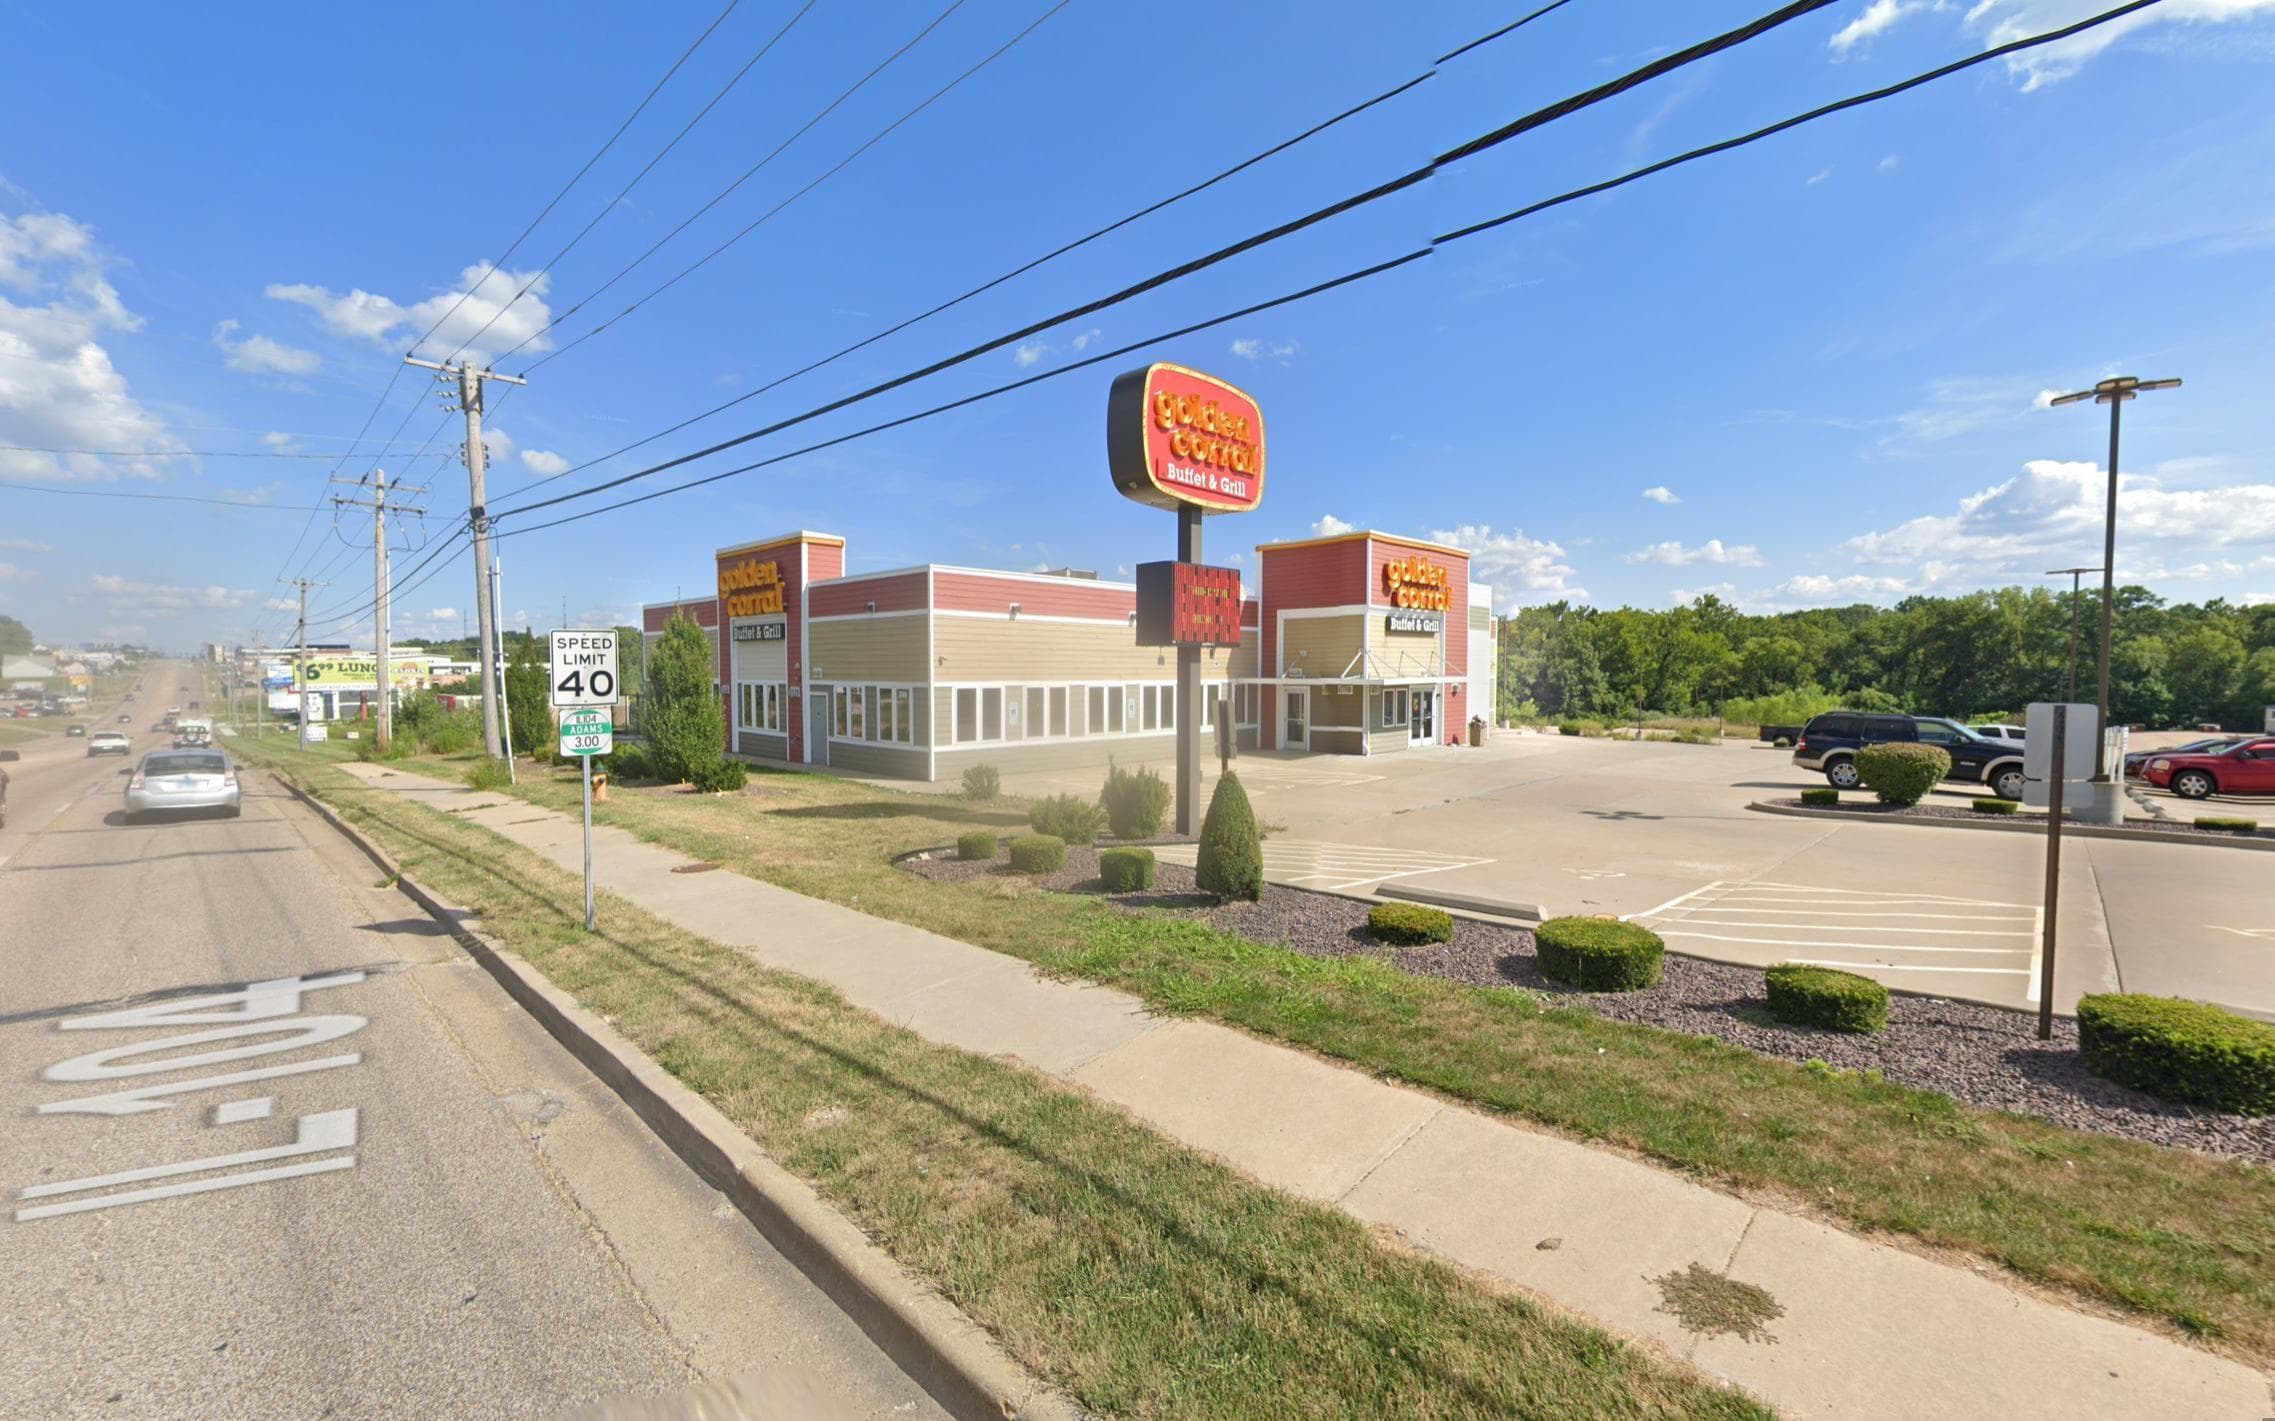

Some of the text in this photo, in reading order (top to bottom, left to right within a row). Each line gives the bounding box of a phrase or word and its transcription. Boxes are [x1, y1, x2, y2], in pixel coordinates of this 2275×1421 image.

[1153, 390, 1250, 441] golden
[1170, 429, 1258, 473] corral
[1167, 462, 1246, 497] Buffet & Grill
[720, 559, 777, 599] golden
[1387, 556, 1448, 589] golden
[727, 582, 785, 616] corral
[1397, 585, 1453, 611] corral
[734, 627, 755, 640] Buffet
[763, 625, 781, 638] Grill
[1390, 617, 1439, 632] Buffet & Grill
[557, 638, 613, 650] SPEED
[338, 662, 377, 673] LUNC
[563, 654, 606, 665] LIMIT
[557, 670, 614, 697] 40
[570, 724, 603, 735] ADAMS
[575, 736, 600, 748] 3.00
